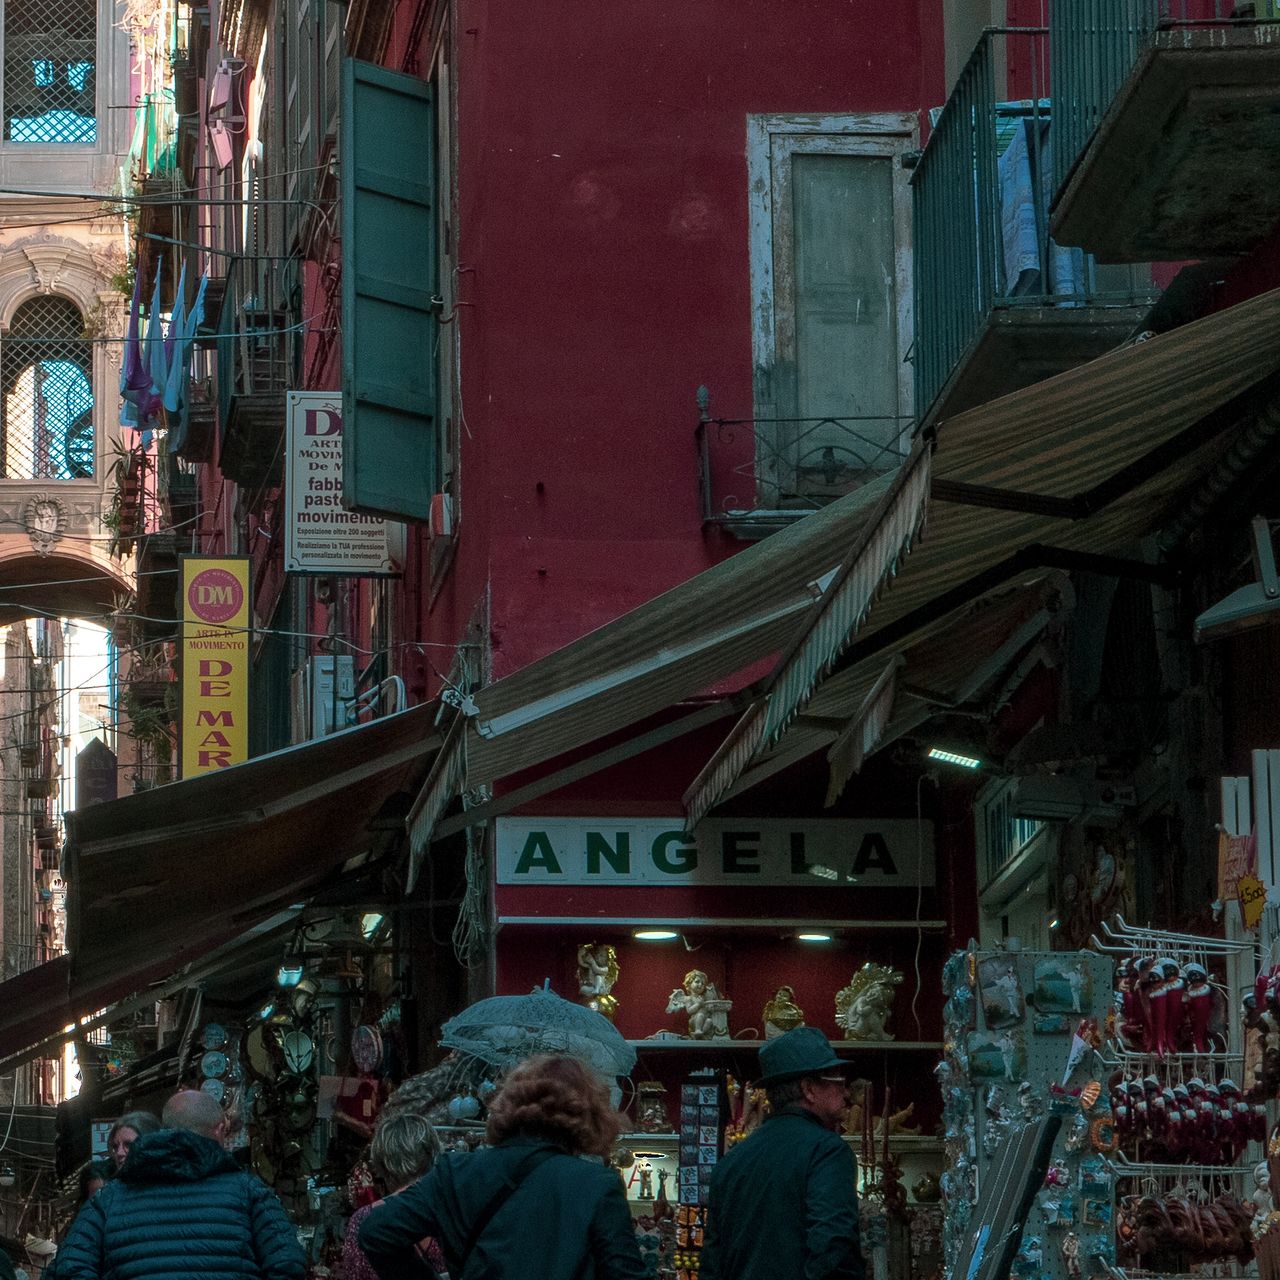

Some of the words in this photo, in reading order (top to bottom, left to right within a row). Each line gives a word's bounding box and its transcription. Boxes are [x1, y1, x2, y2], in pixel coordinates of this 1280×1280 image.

[304, 409, 343, 436] D
[310, 440, 343, 448] ART
[308, 462, 329, 471] De
[297, 527, 332, 536] Esposizione
[348, 528, 360, 536] 200
[360, 528, 385, 538] soggetti
[297, 541, 330, 550] Realizziamo
[339, 542, 351, 550] TUA
[352, 542, 385, 551] professione
[301, 552, 342, 560] personalizzata
[350, 552, 382, 561] movimento
[198, 585, 233, 605] DM
[189, 641, 245, 650] MOVIMENTO
[199, 660, 233, 697] DE
[514, 830, 898, 875] ANGELA
